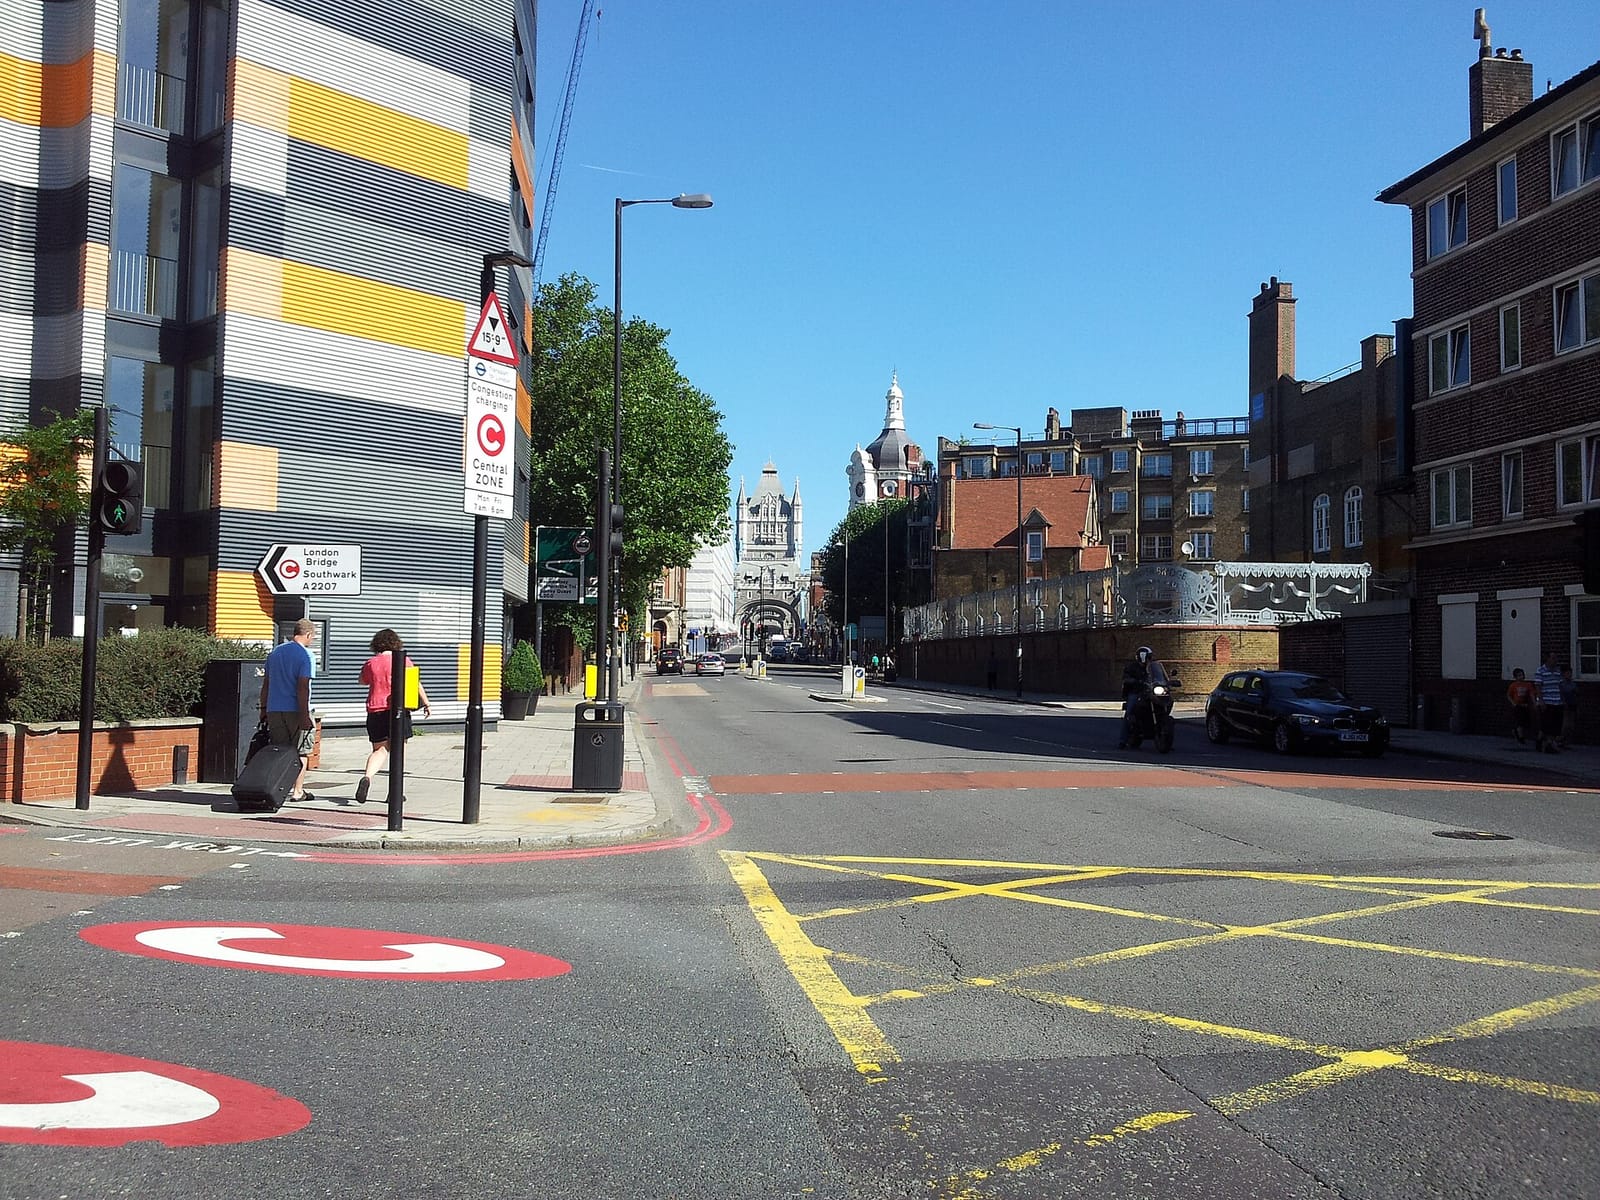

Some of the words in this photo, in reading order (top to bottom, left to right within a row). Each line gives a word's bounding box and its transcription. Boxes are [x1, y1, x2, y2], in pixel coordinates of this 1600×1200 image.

[471, 381, 514, 401] Congestion
[476, 396, 509, 413] charging
[472, 458, 508, 475] Central
[475, 473, 504, 489] ZONE
[303, 548, 339, 557] London
[306, 557, 338, 567] Bridge
[303, 570, 357, 579] Southwark
[302, 582, 337, 591] A2207
[45, 834, 154, 847] LEFT
[155, 840, 264, 856] LOOK
